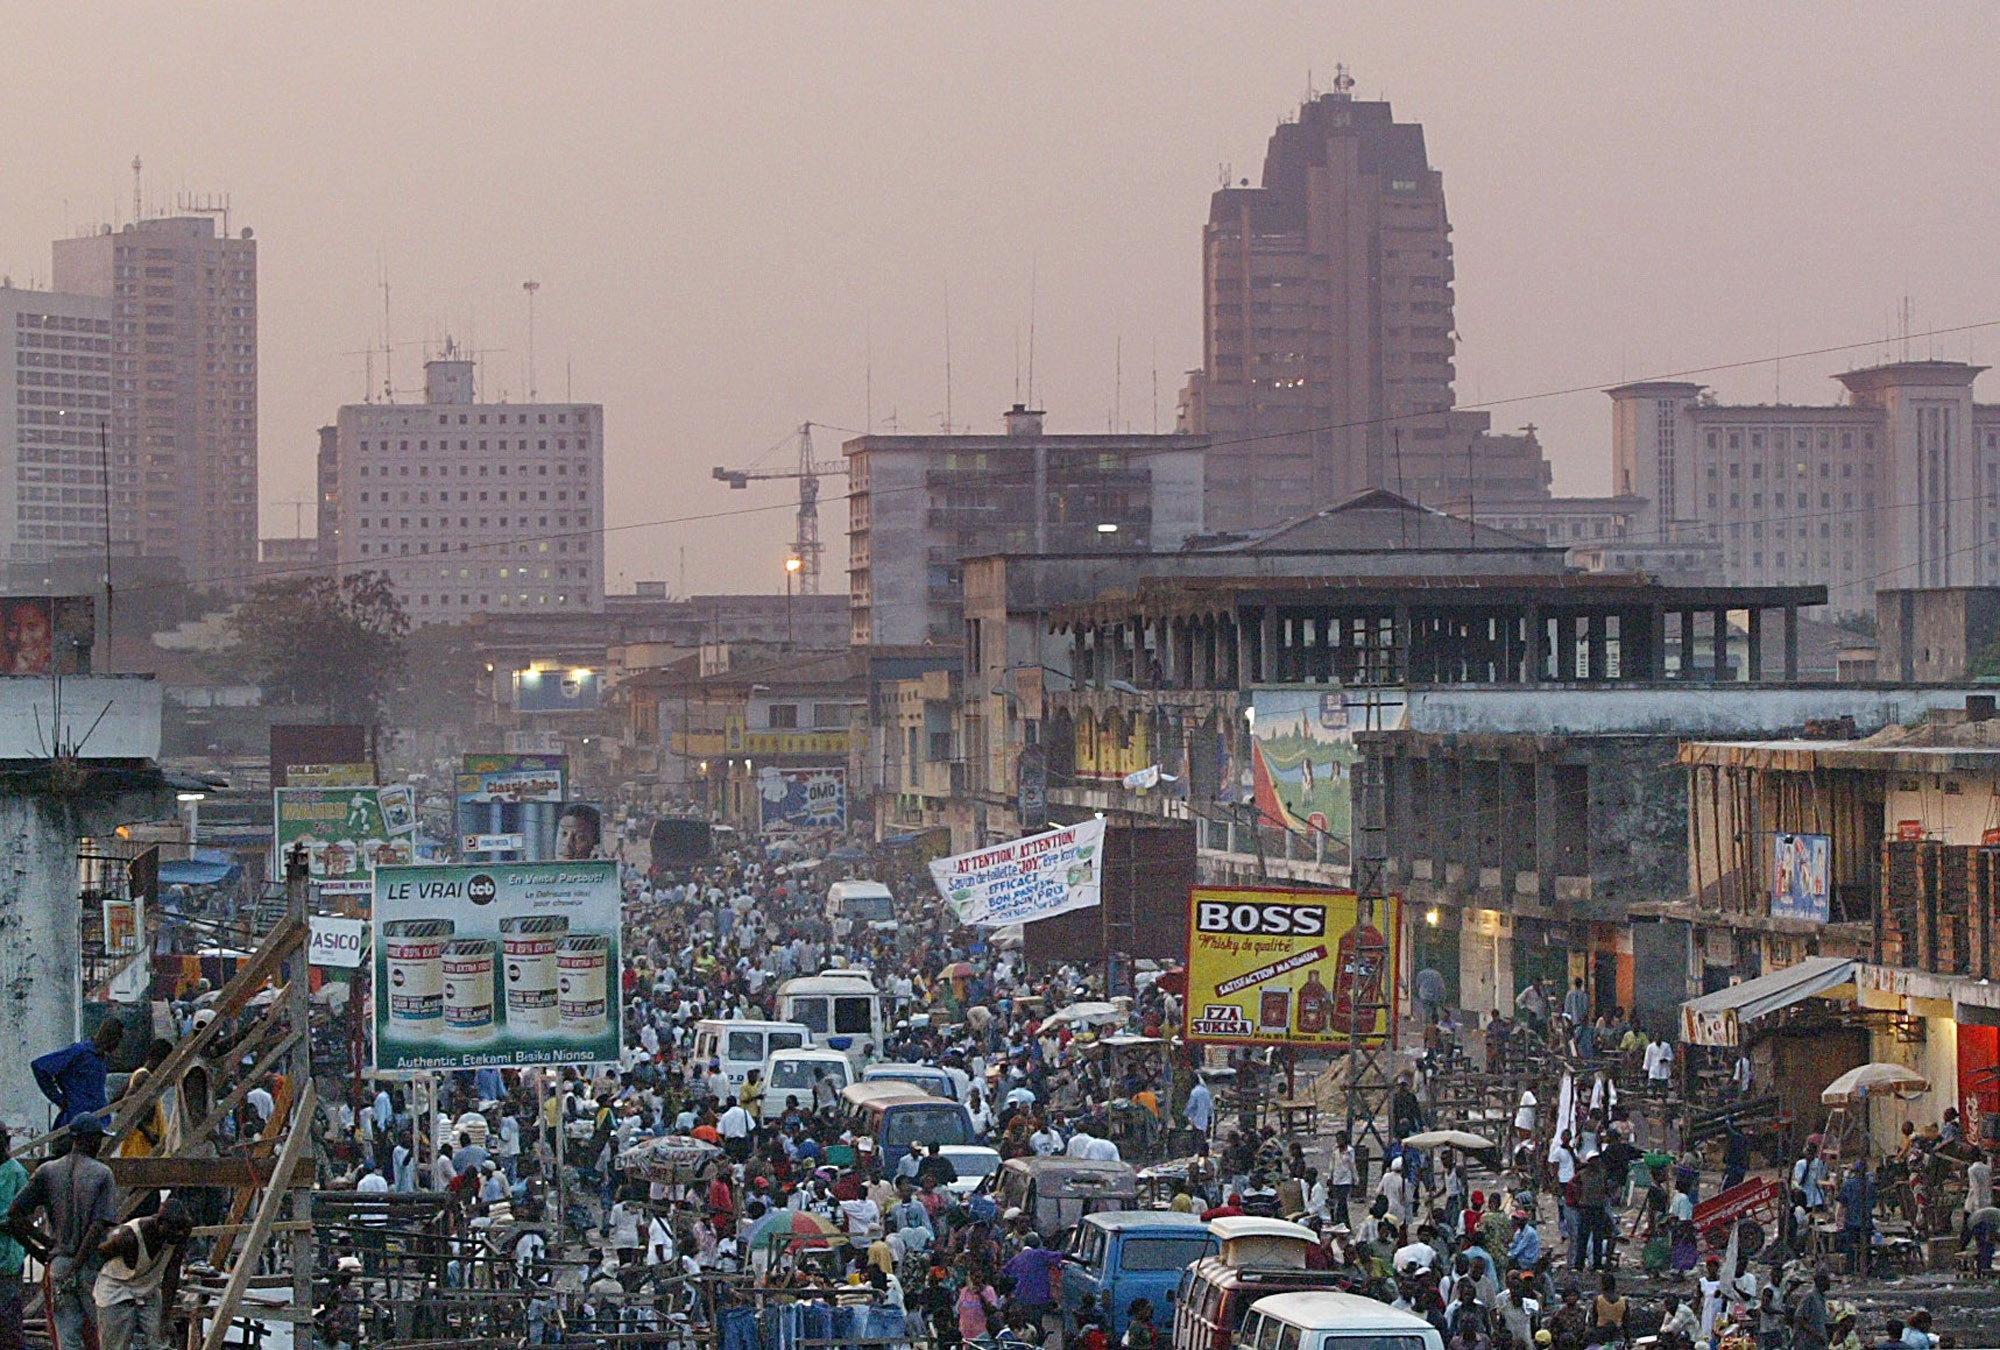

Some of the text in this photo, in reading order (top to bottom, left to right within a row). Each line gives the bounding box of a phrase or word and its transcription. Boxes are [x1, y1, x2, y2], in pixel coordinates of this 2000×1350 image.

[809, 784, 836, 800] OMO
[387, 882, 495, 900] LE VRAI tcb
[1199, 903, 1323, 934] BOSS
[308, 928, 360, 951] ASICO
[1207, 1007, 1239, 1020] EZA
[1192, 1021, 1250, 1035] SUKISA
[397, 1050, 595, 1068] Authentic Etekami Bisika Nionso
